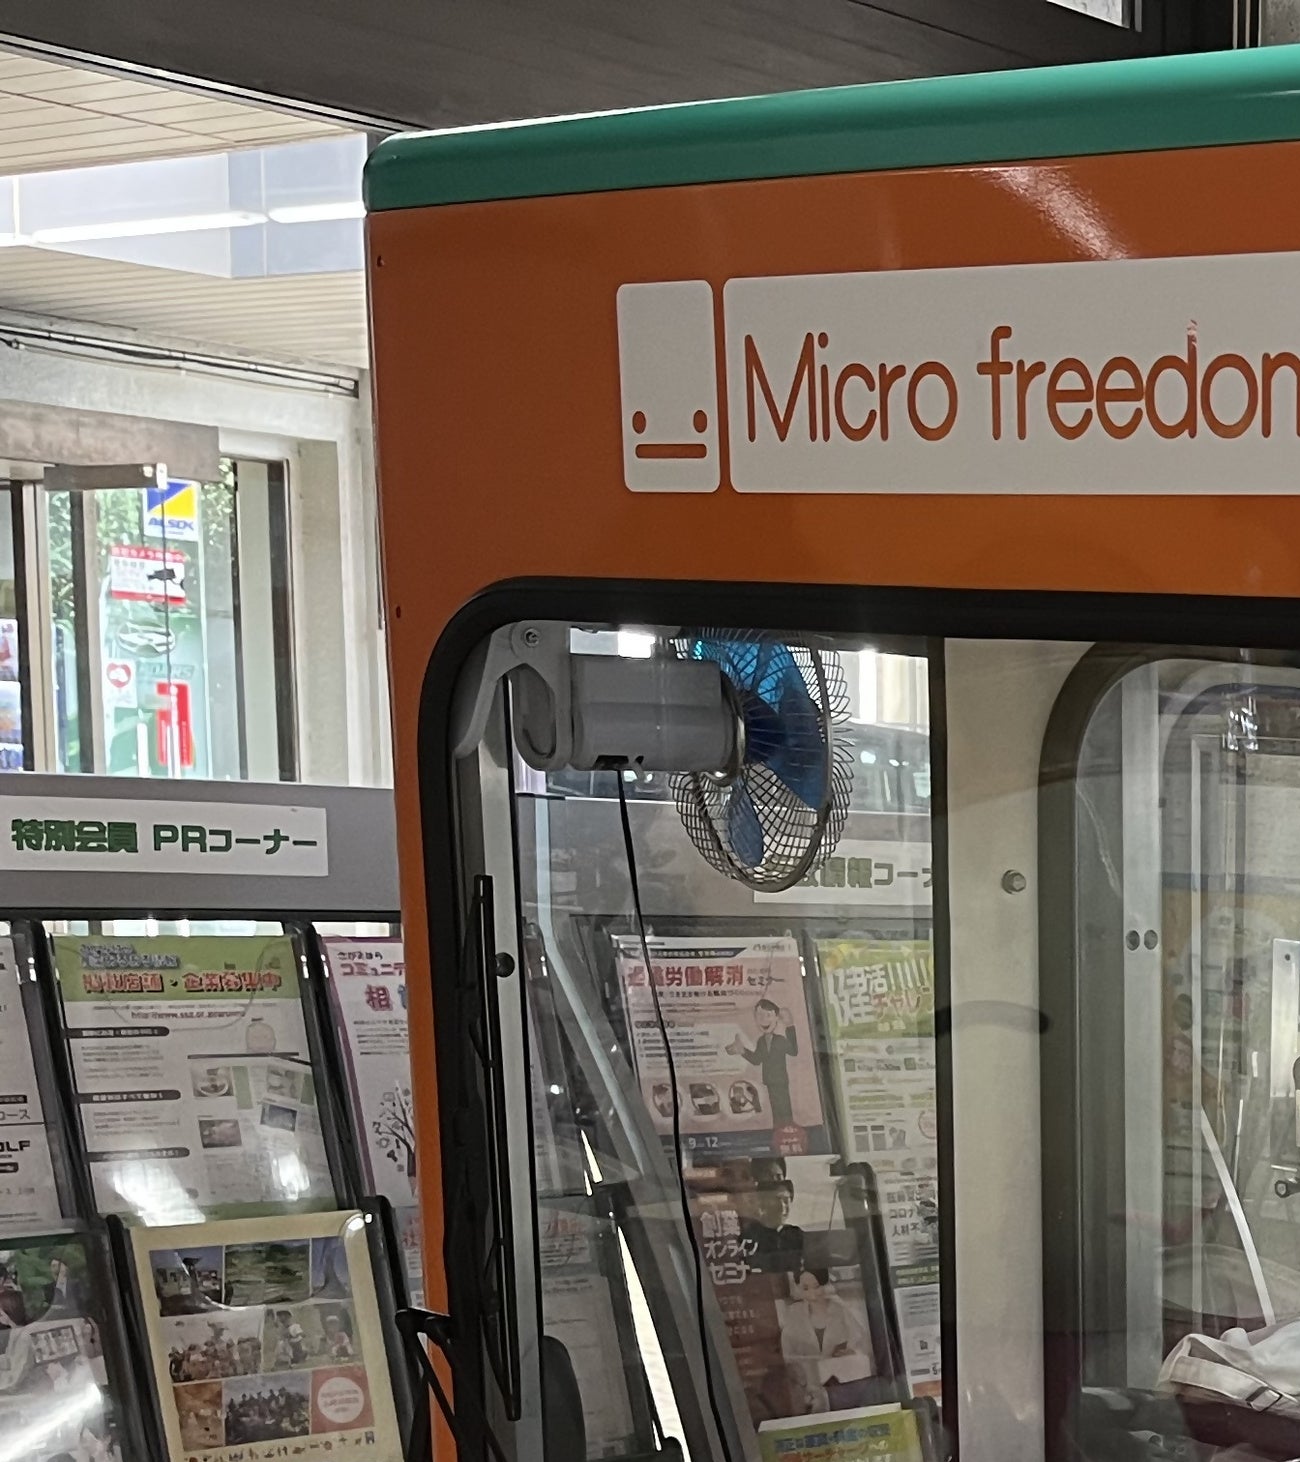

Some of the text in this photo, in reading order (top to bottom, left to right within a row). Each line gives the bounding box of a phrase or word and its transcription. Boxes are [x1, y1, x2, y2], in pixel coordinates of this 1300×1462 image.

[743, 331, 959, 443] Micro
[11, 818, 318, 855] 特別会員 PRコーナー
[703, 1238, 759, 1259] オンライン
[707, 1260, 763, 1286] セミナー
